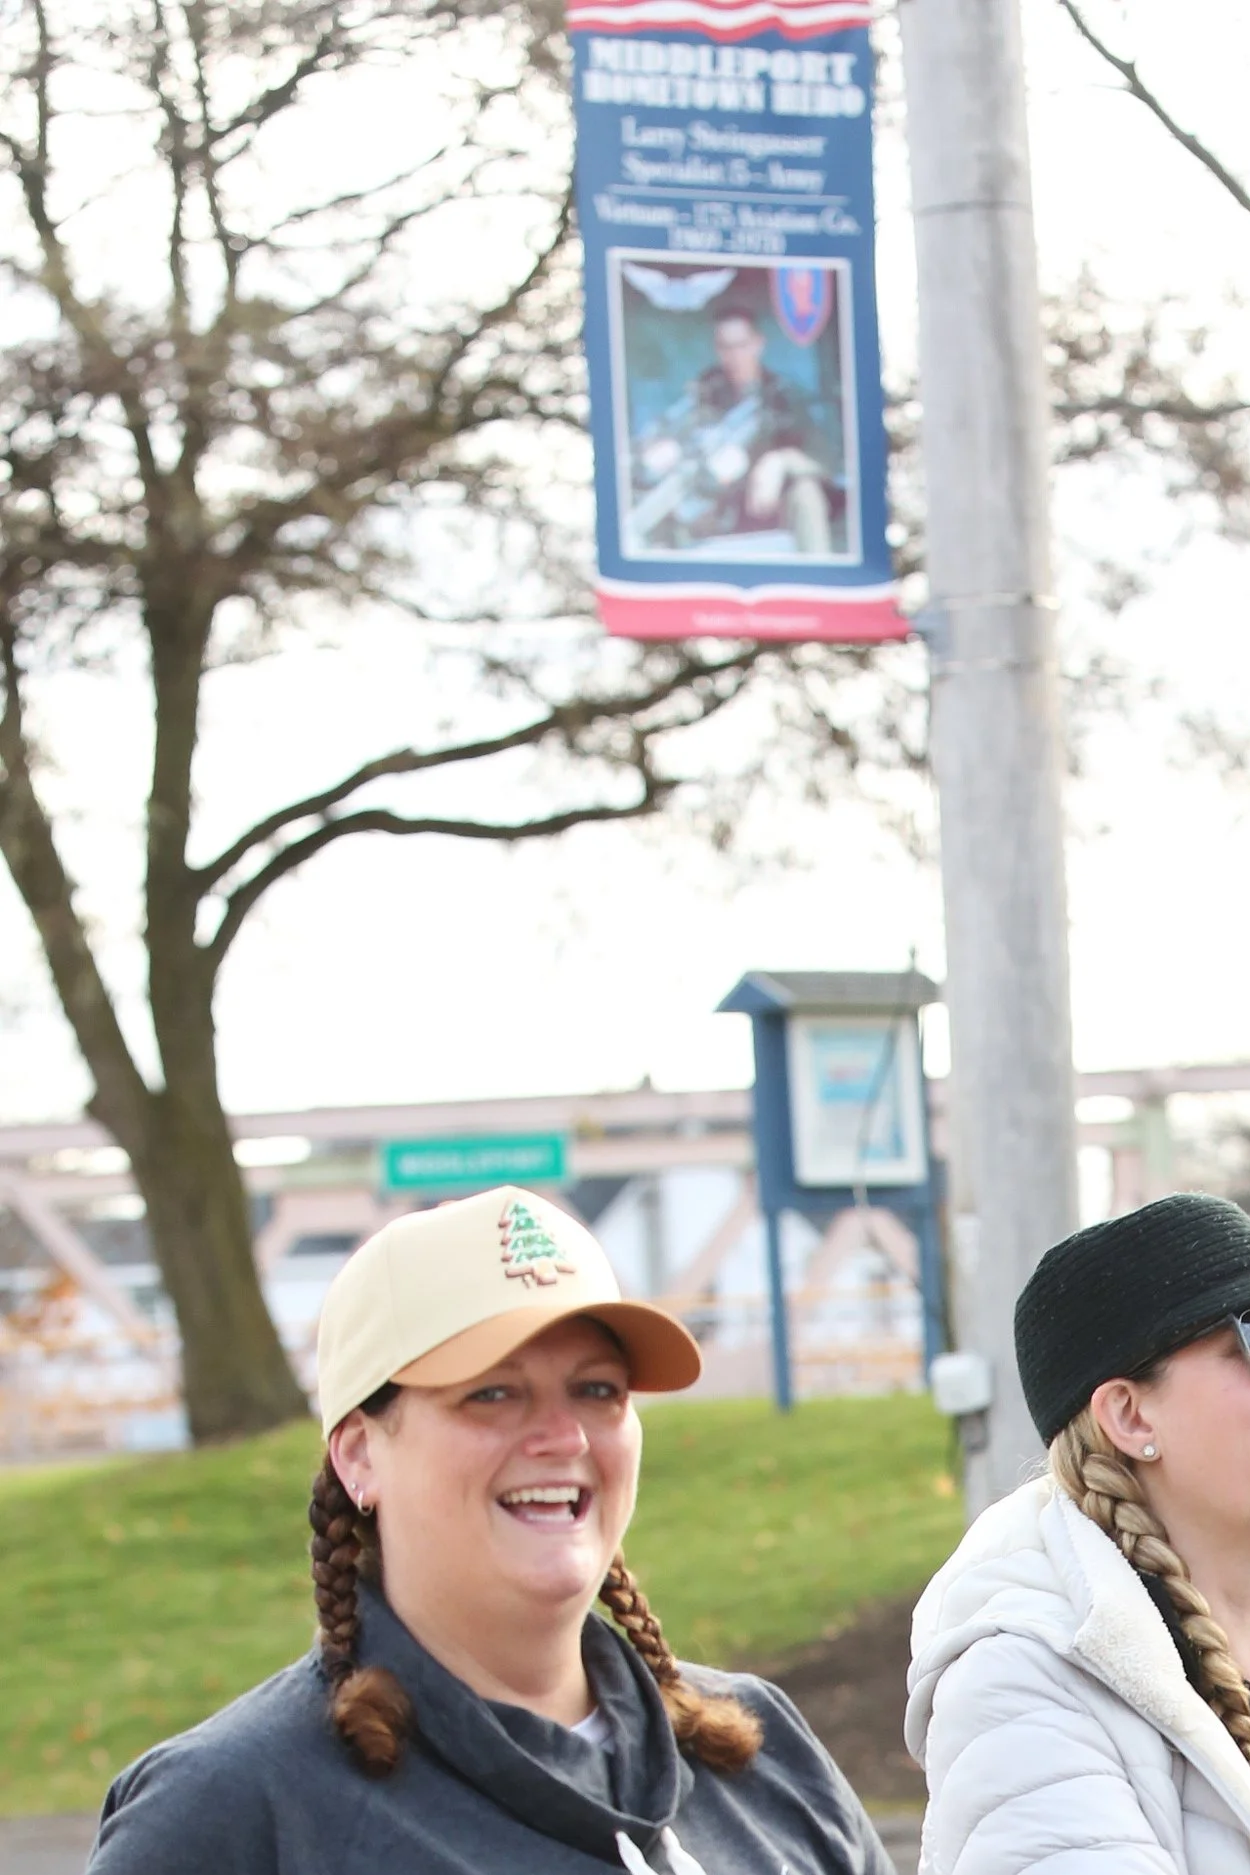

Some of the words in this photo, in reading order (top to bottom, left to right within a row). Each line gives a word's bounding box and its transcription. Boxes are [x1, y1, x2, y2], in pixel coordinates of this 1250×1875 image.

[591, 40, 856, 82] MIDDLEPORT
[585, 72, 764, 110] HOMETOWN
[774, 83, 864, 116] HERO
